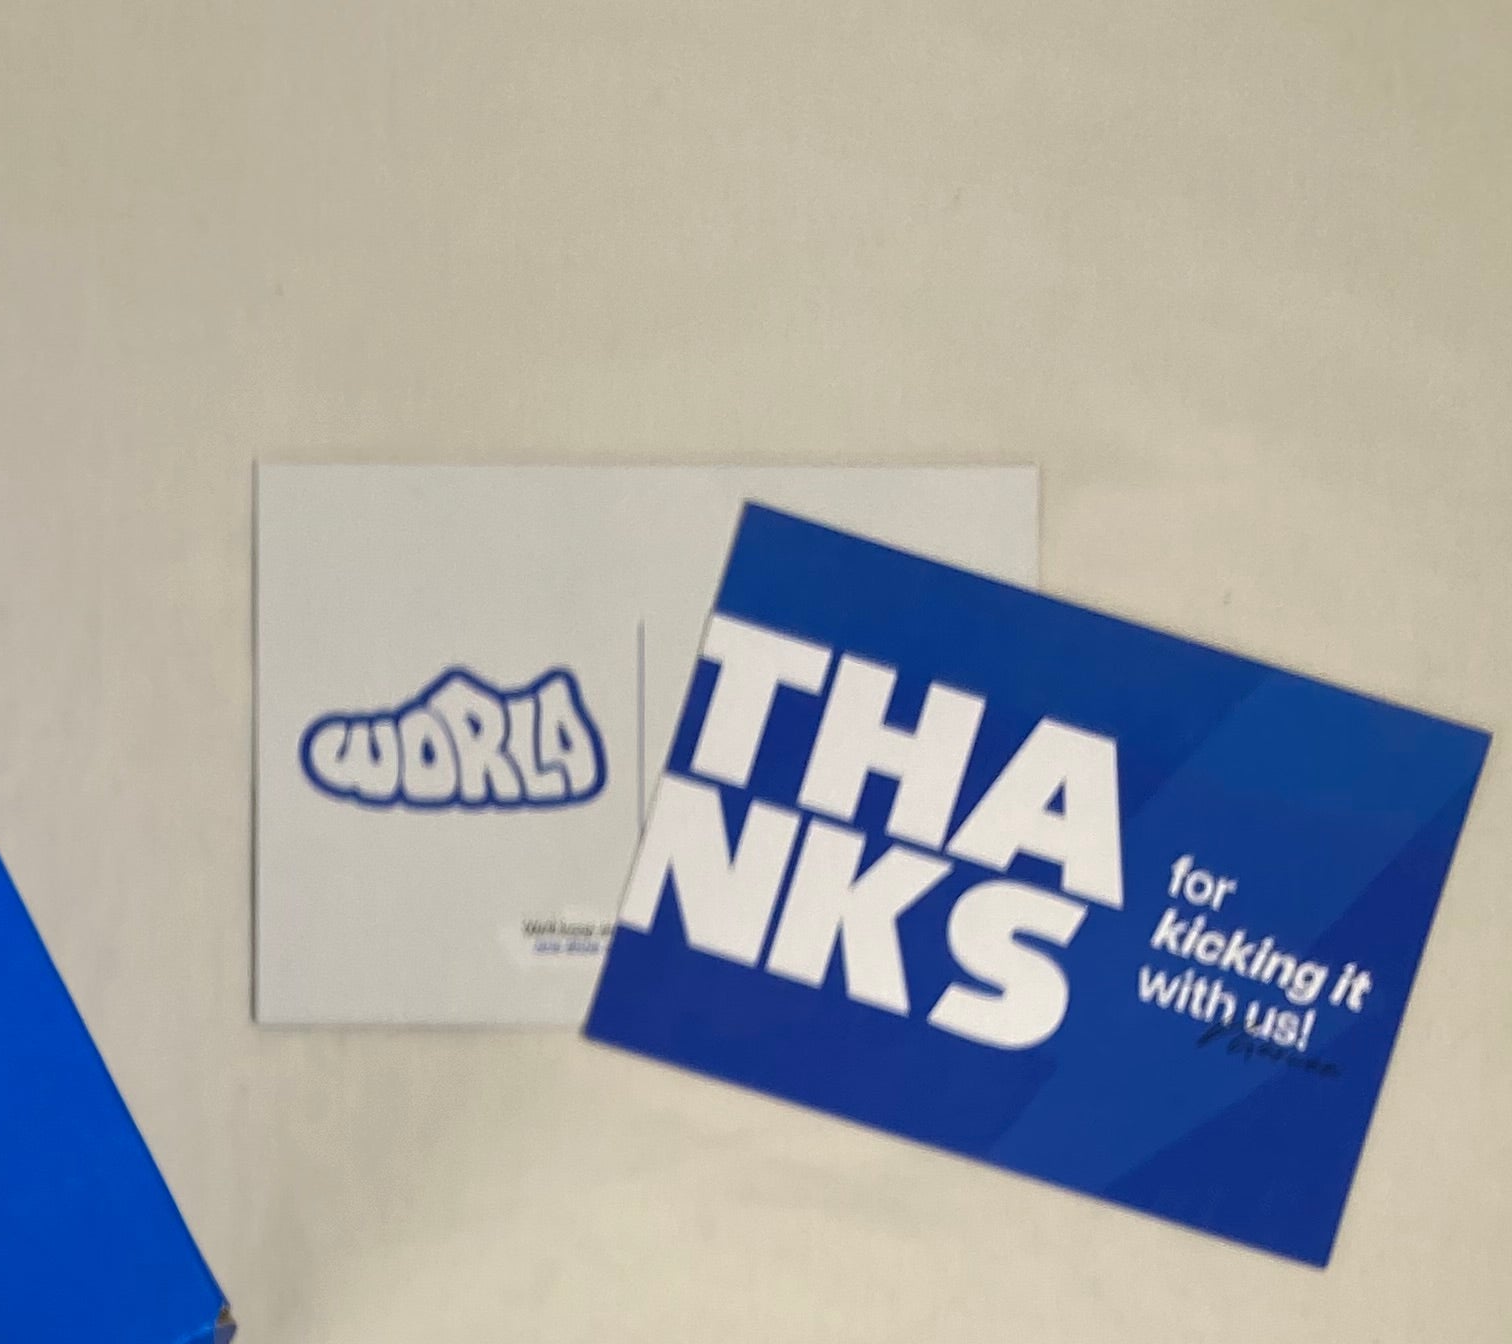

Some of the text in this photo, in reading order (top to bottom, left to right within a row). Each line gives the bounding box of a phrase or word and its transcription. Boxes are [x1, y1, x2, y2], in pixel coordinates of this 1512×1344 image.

[698, 611, 1124, 910] THA
[619, 772, 1088, 1052] NKS
[1167, 853, 1238, 911] for
[1138, 964, 1238, 1026] with
[1243, 999, 1317, 1054] us!
[1149, 906, 1374, 1014] kicking it
